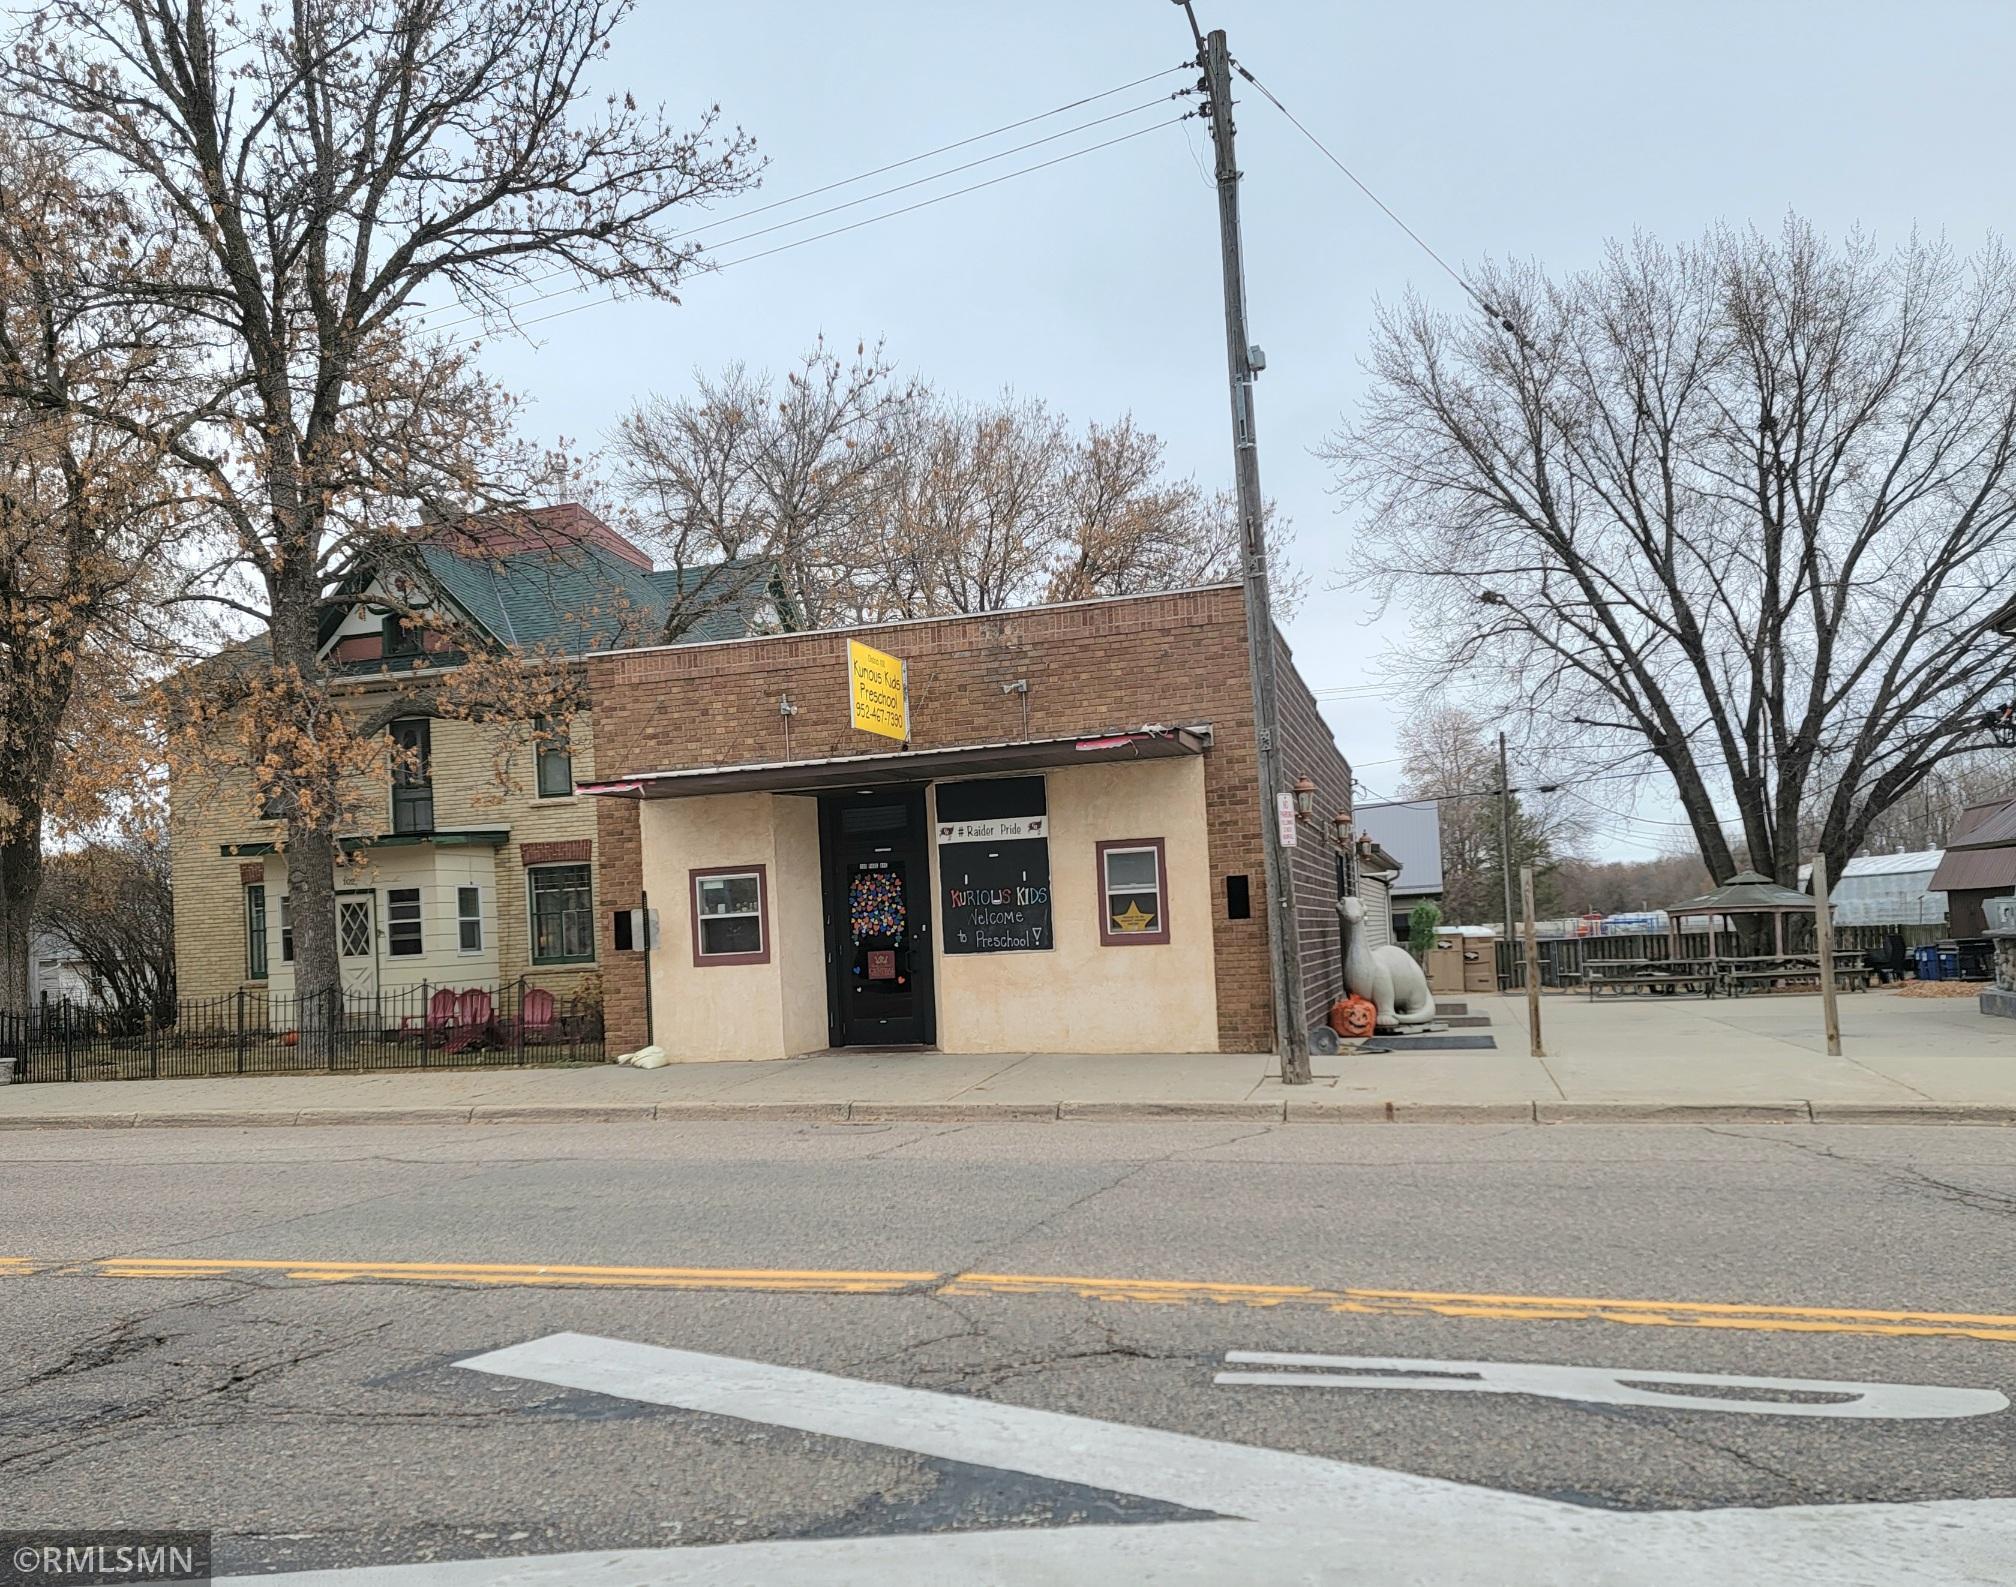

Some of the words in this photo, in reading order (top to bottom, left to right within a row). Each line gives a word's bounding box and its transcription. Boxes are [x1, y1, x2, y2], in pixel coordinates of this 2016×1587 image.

[884, 671, 901, 691] Kids
[860, 683, 897, 709] Preschool
[1000, 822, 1021, 835] Pride
[951, 889, 1011, 908] KURIOUS
[1016, 886, 1047, 906] KIDS
[957, 929, 968, 943] to
